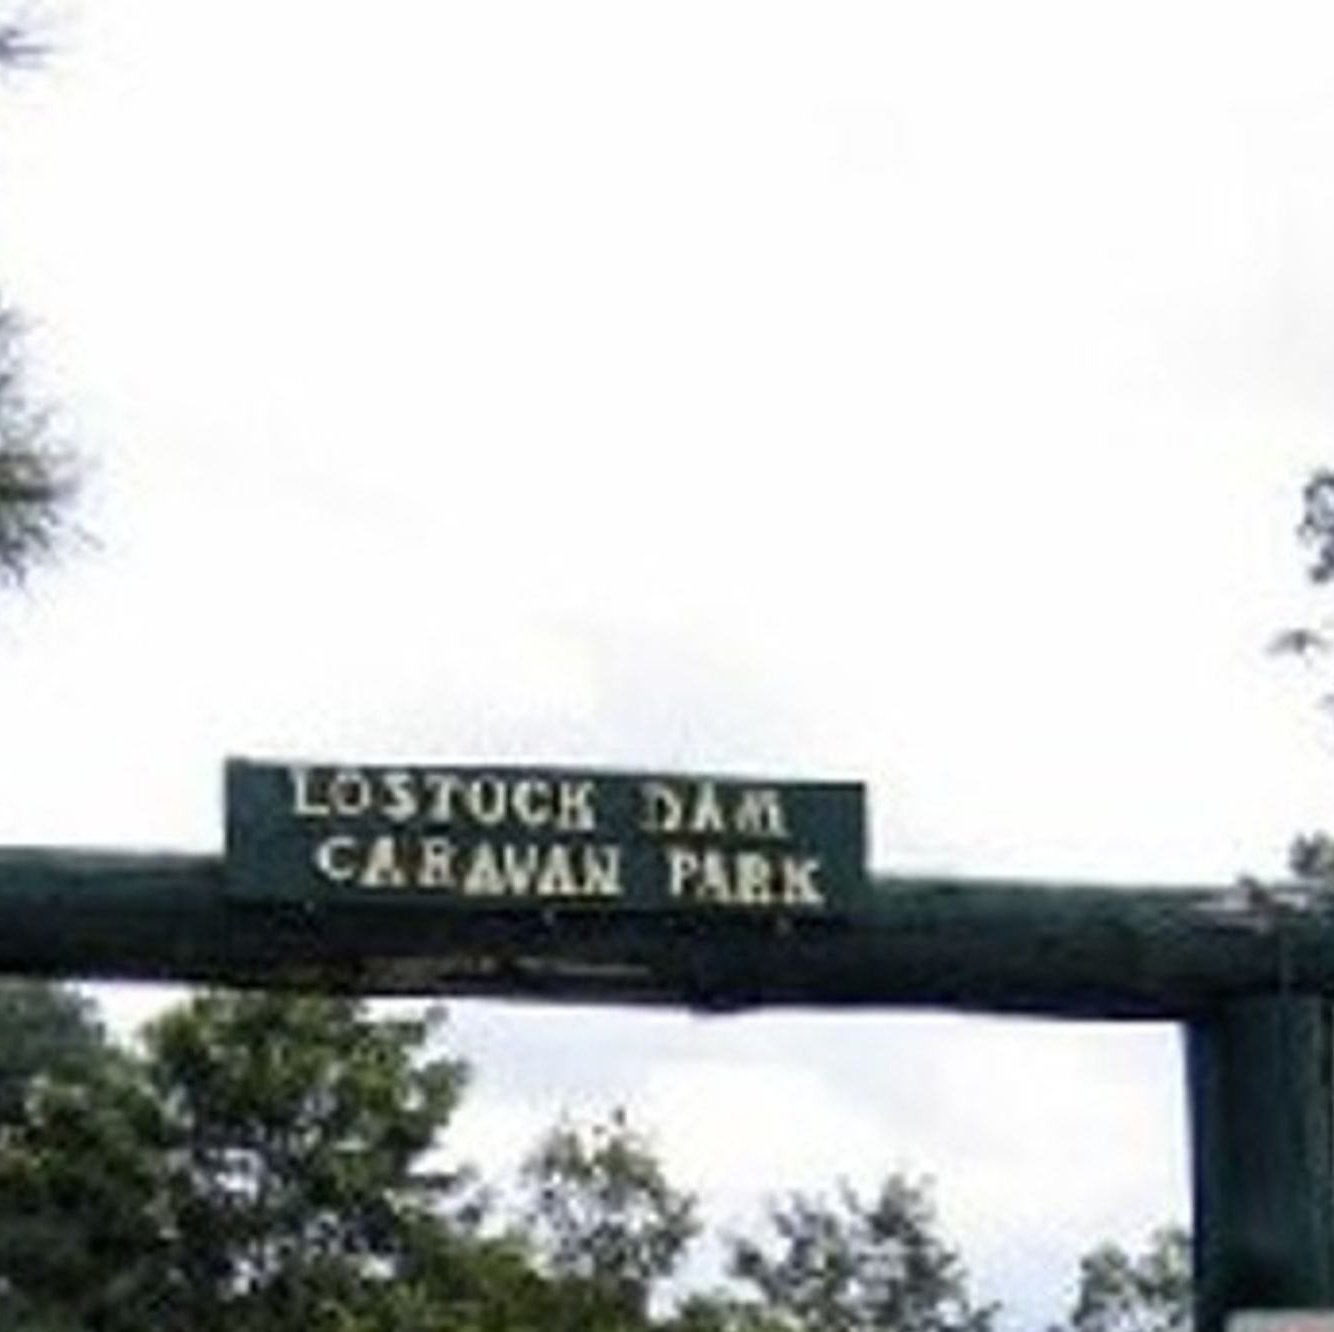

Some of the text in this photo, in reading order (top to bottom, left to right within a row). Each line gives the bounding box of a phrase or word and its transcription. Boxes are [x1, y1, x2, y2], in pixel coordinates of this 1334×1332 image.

[291, 767, 788, 838] LOSTOCK DAM
[316, 835, 826, 906] CARAVAN PARK
